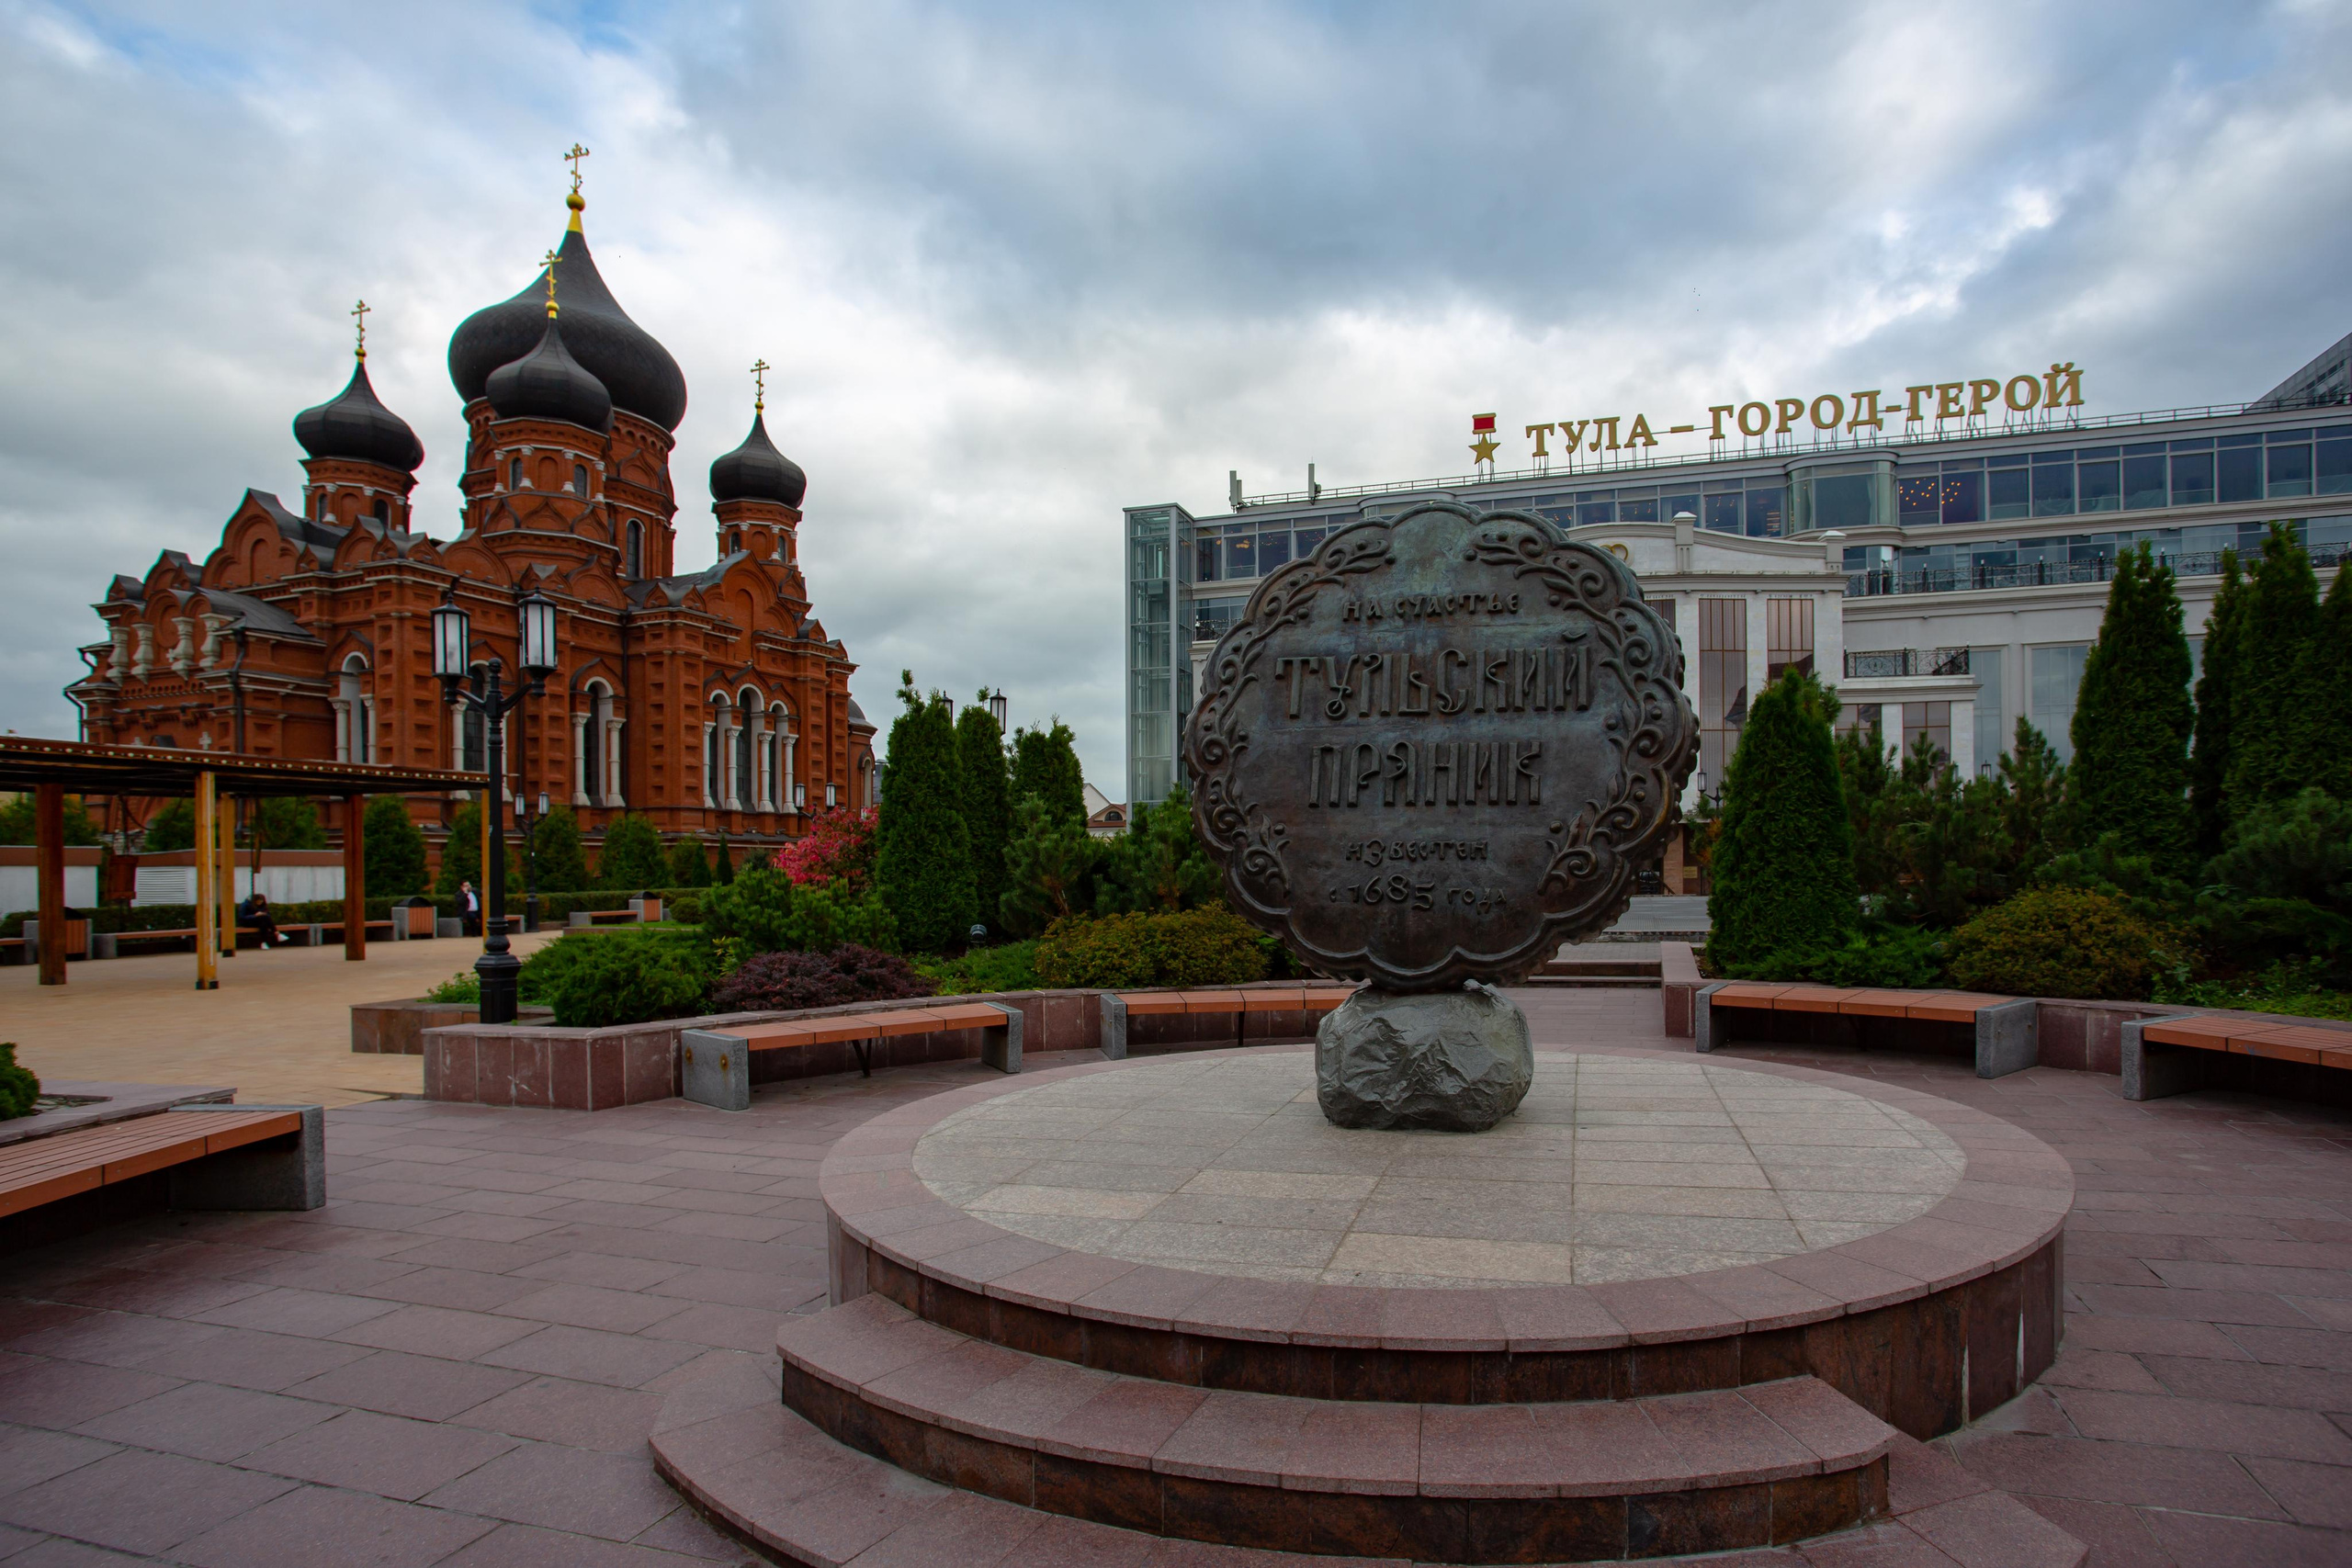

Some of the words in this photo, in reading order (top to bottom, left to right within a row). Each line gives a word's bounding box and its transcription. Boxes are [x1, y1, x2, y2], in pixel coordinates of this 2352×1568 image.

[1525, 413, 1658, 457] ТУЛА
[1342, 597, 1383, 622] НА
[1395, 592, 1520, 618] СЧАСТЬЕ
[1274, 631, 1589, 721] ТУЛЬСКИЙ
[1309, 741, 1542, 807] ПРЯНИК
[1348, 874, 1435, 911] 1685
